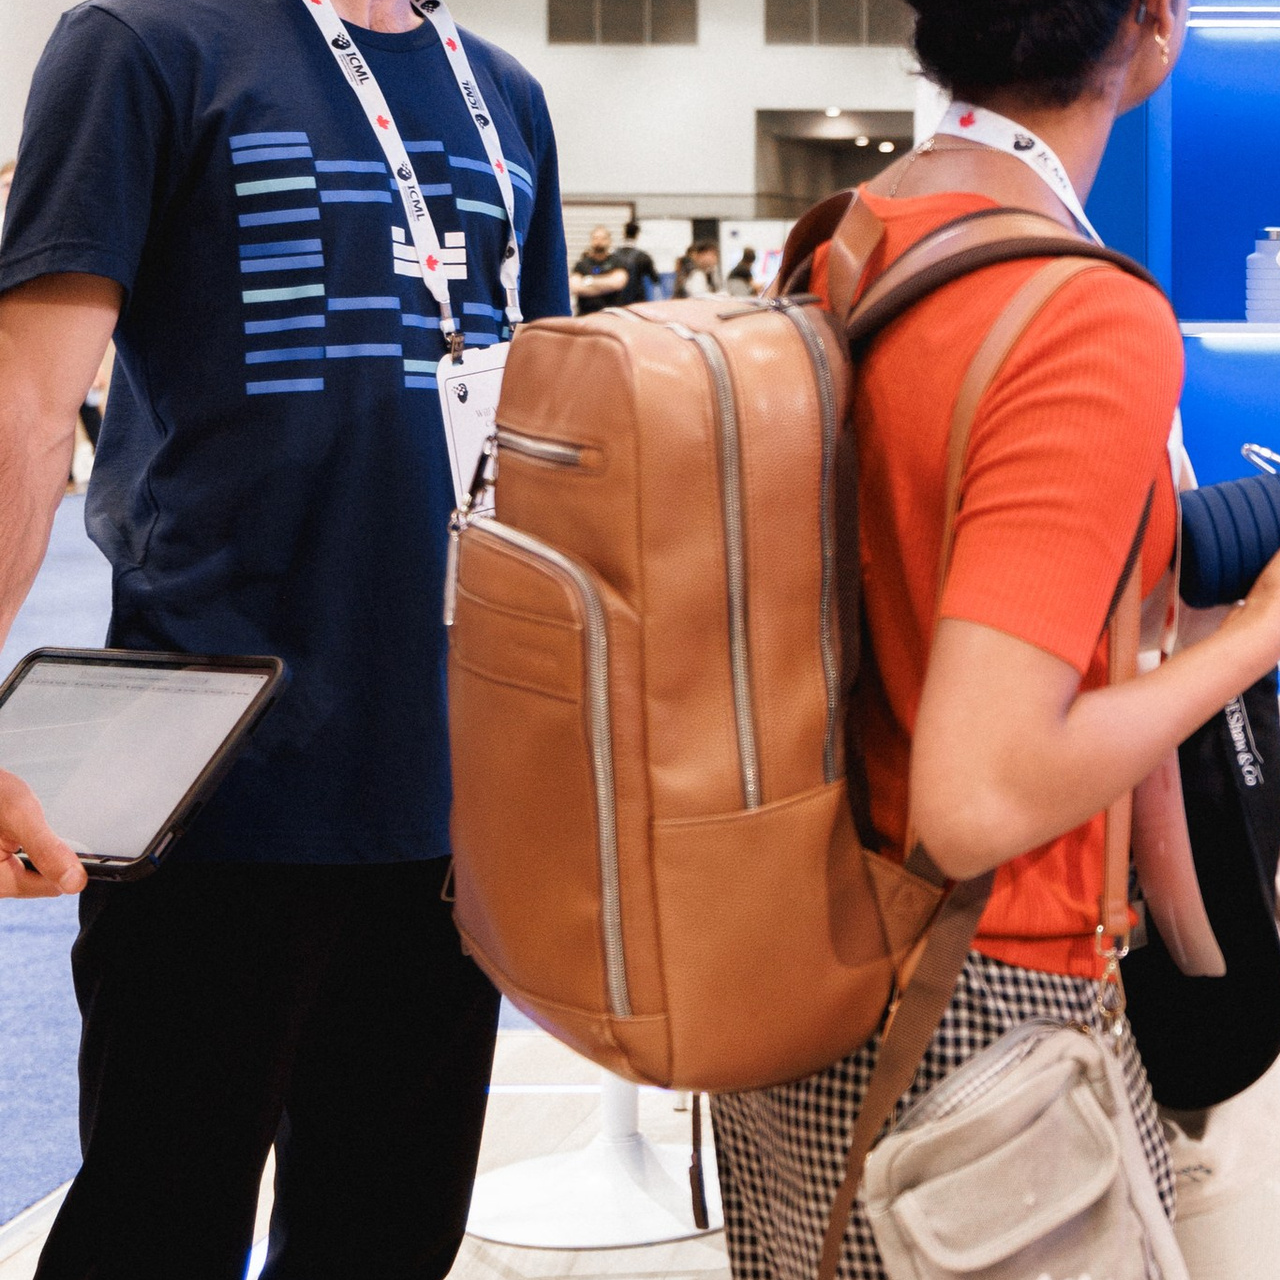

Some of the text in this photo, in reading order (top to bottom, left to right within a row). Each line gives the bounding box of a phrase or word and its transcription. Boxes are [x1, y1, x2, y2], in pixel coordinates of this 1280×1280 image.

[346, 51, 371, 87] ICML
[462, 79, 479, 112] ICML
[406, 184, 426, 222] ICML
[1237, 751, 1254, 766] &
